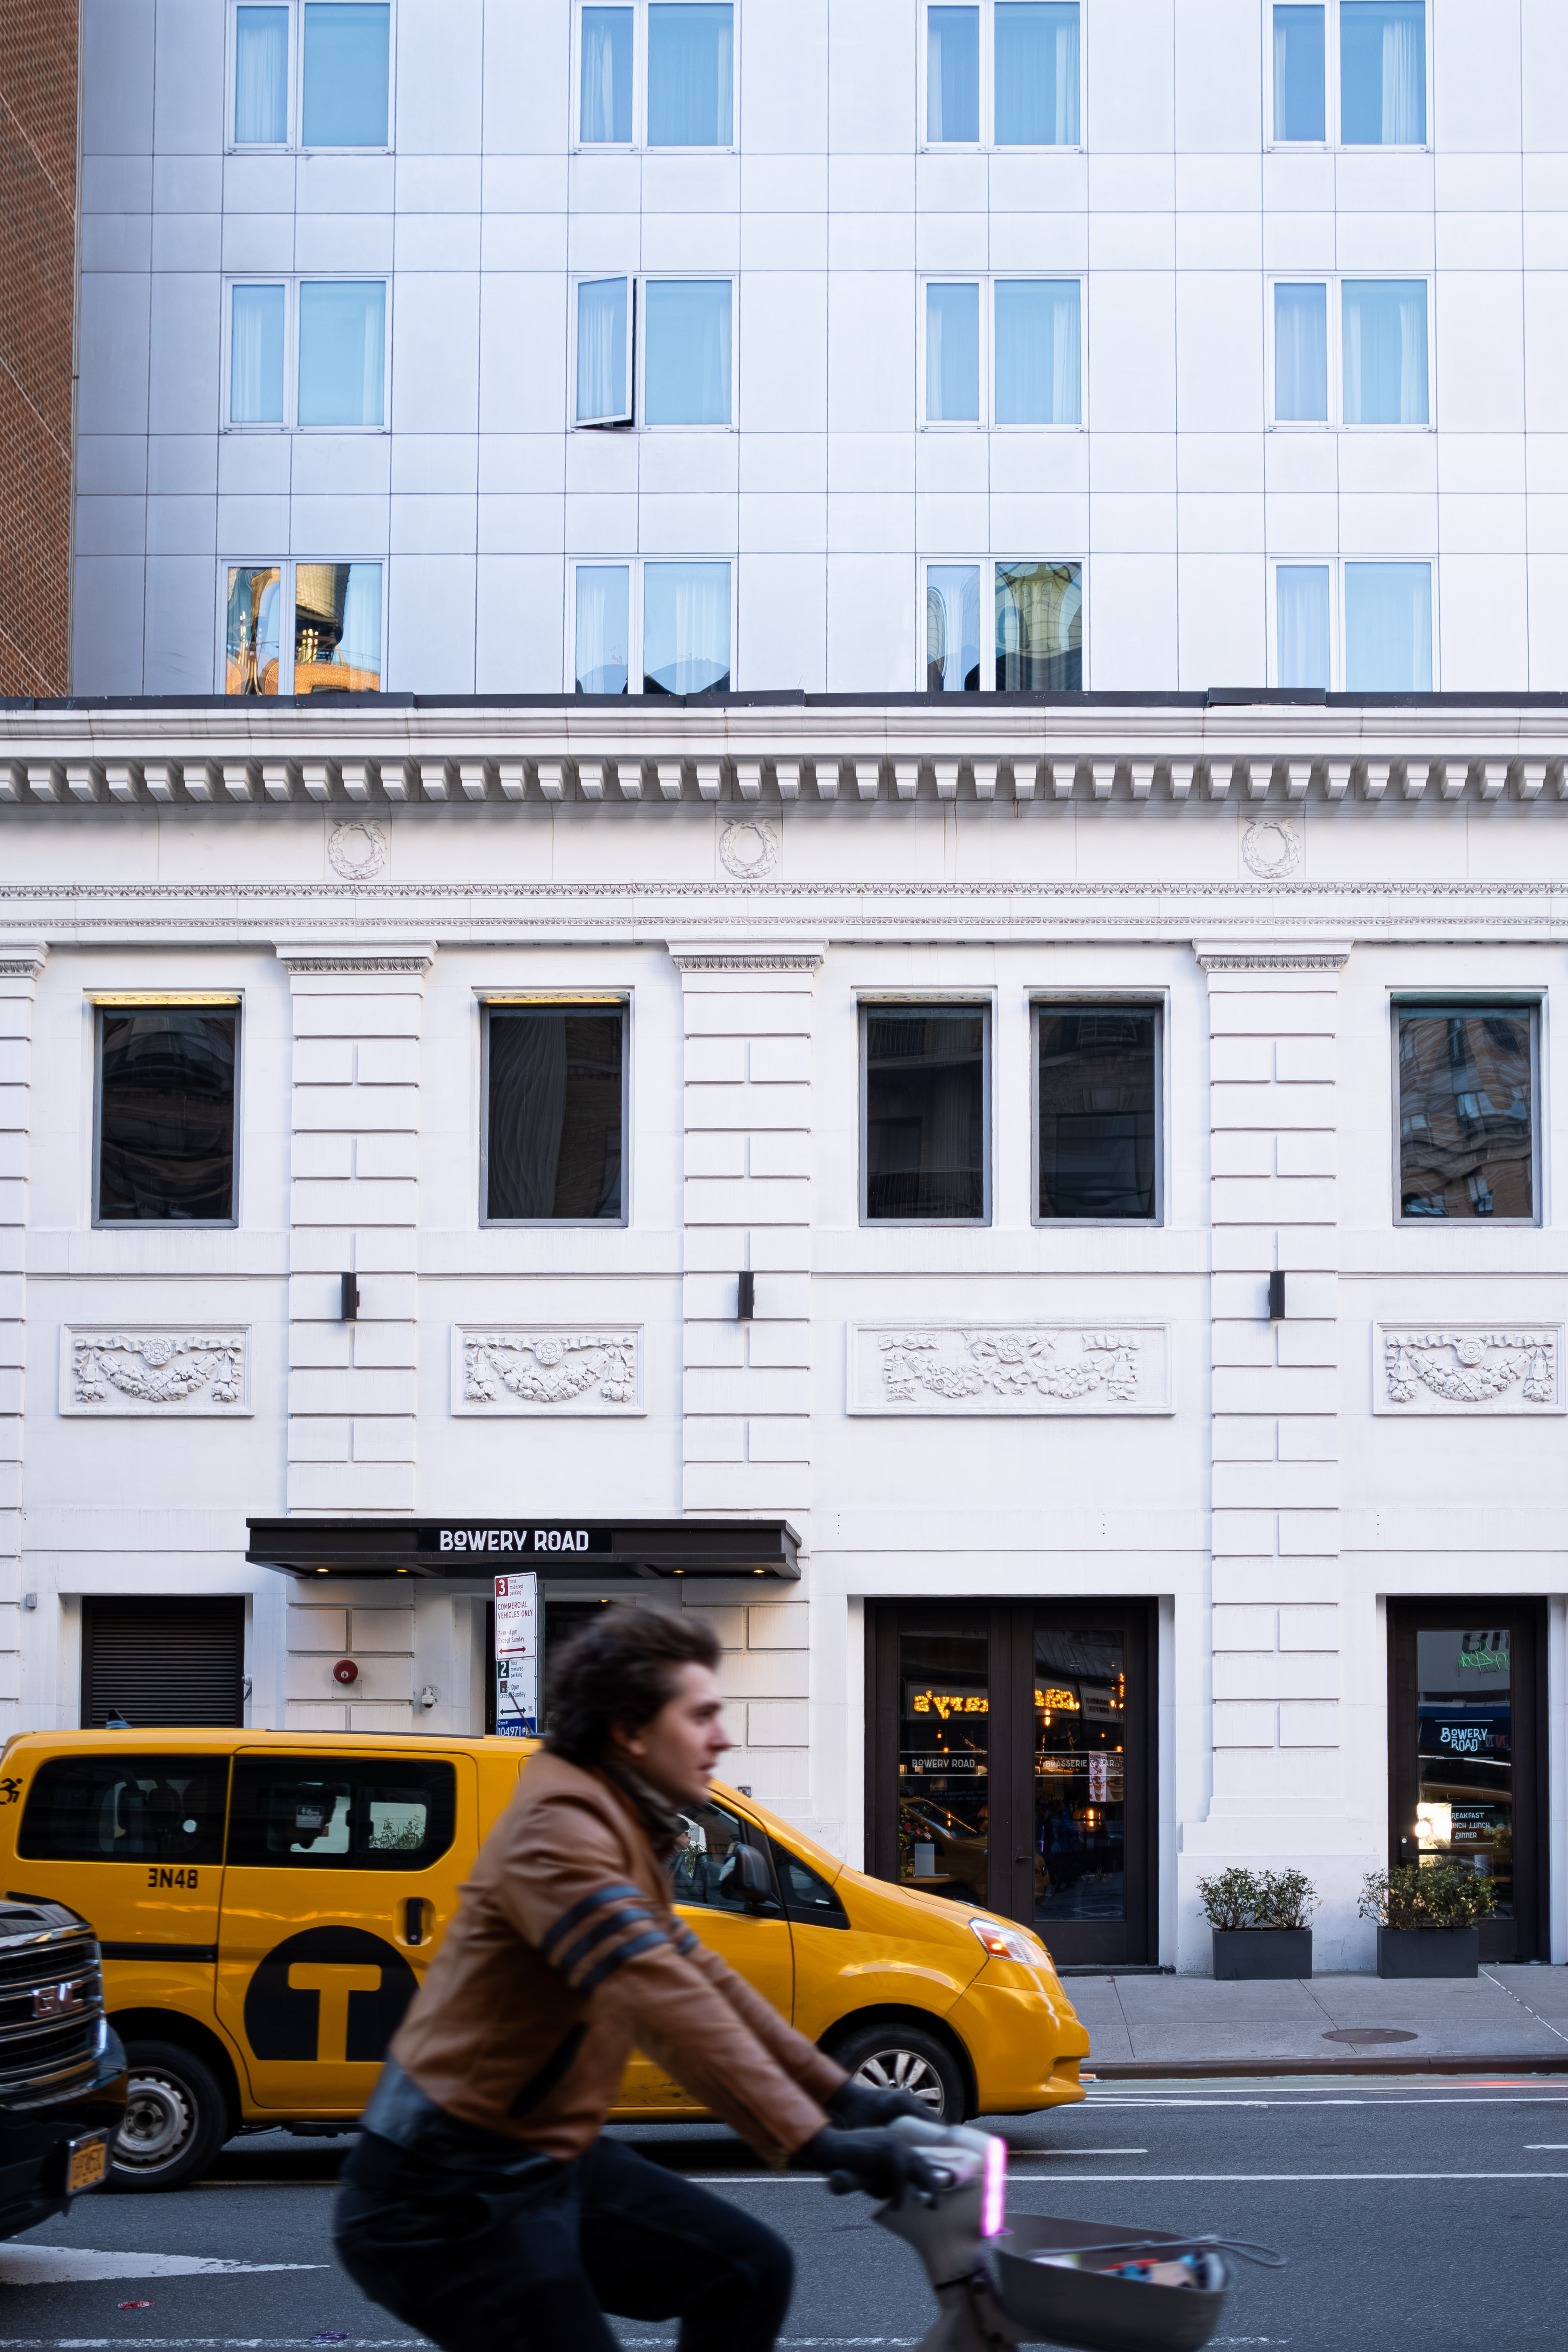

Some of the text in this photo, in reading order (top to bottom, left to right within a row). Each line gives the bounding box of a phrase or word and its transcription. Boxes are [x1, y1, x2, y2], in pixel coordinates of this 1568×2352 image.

[440, 1530, 588, 1551] BOWERY ROAD
[498, 1579, 506, 1595] 3
[498, 1601, 528, 1610] COMMERCIAL
[498, 1609, 533, 1619] VEHICLES ONLY
[500, 1661, 507, 1677] 2
[498, 1726, 521, 1736] 104971
[1441, 1727, 1487, 1742] BOWERY
[1452, 1739, 1478, 1752] ROAD
[912, 1759, 975, 1768] BOWERY ROAD
[1448, 1812, 1484, 1820] REAKFAST
[147, 1868, 198, 1889] 3N48
[288, 1962, 382, 2063] T
